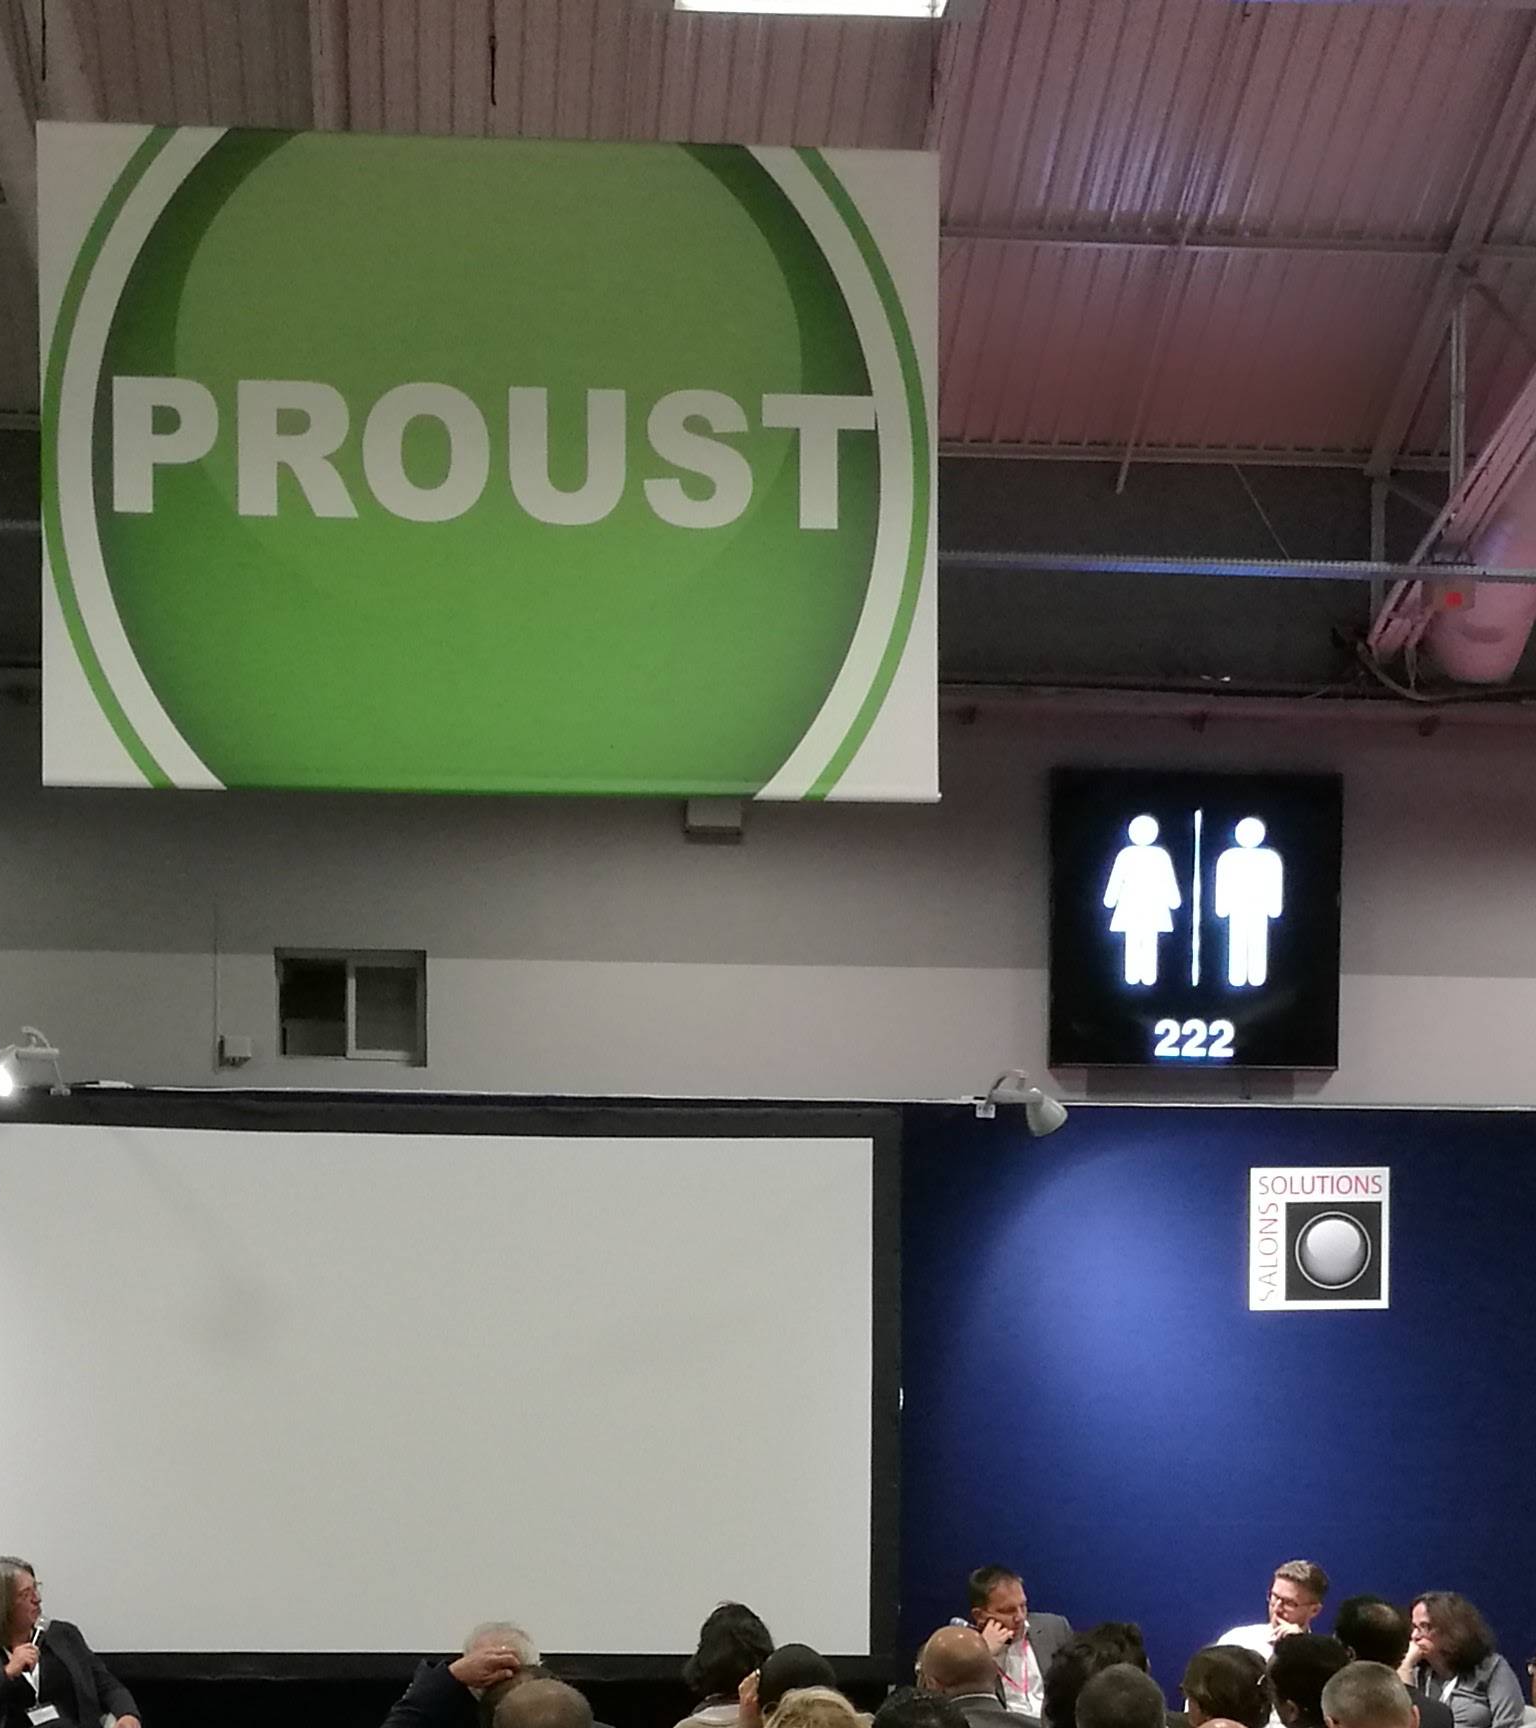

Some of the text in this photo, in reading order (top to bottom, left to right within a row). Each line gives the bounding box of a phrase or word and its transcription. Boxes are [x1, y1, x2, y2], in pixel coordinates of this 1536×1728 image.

[111, 376, 876, 530] PROUST
[1154, 1018, 1235, 1058] 222
[1257, 1174, 1383, 1196] SOLUTIONS
[1257, 1201, 1280, 1302] SALONS
